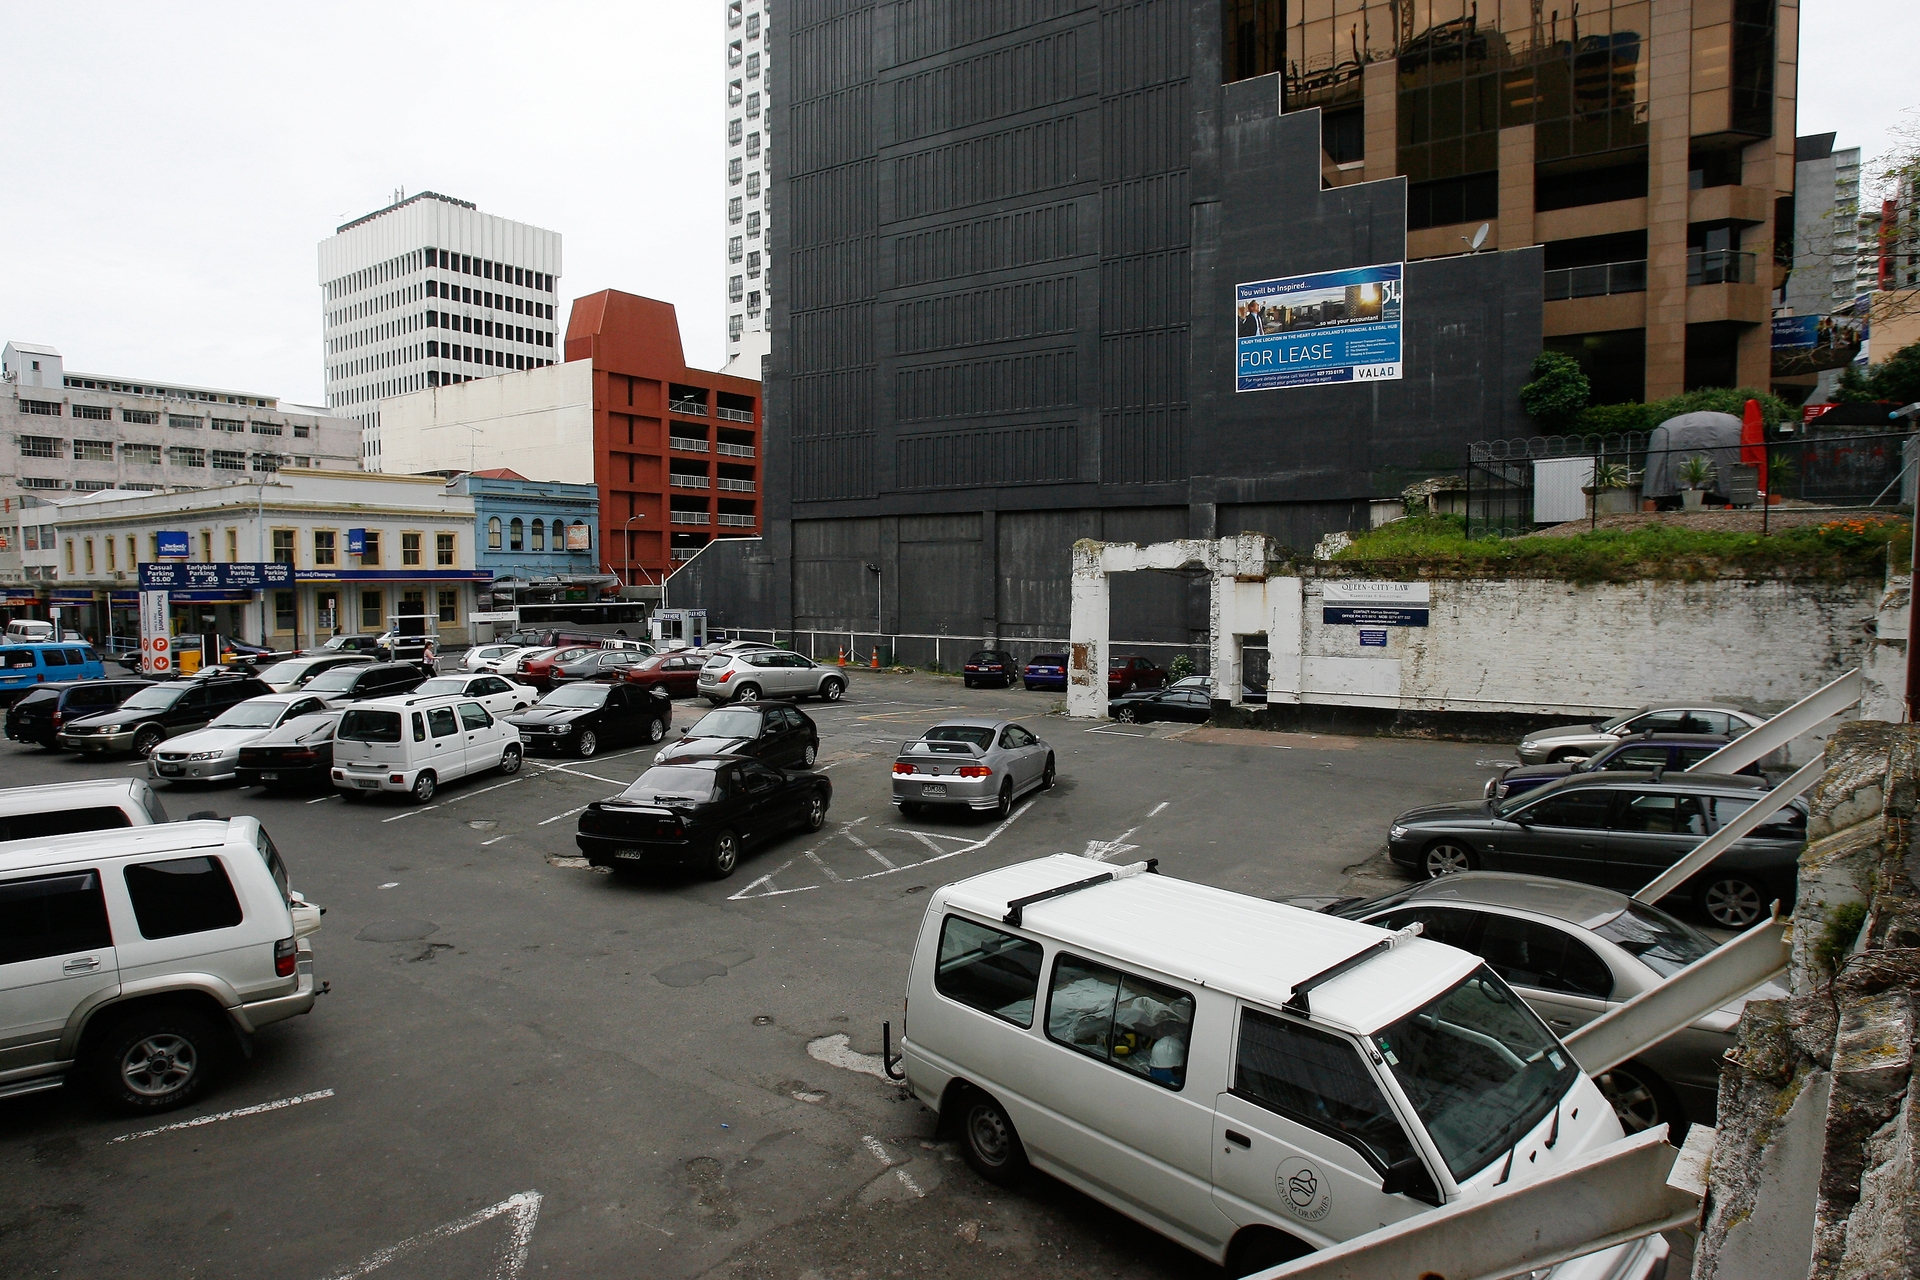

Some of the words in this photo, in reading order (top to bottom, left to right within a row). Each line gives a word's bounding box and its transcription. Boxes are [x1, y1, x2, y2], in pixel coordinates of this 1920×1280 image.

[1240, 350, 1273, 367] FOR
[1279, 343, 1333, 363] LEASE
[1358, 366, 1394, 378] VALAD
[1342, 583, 1366, 591] QUEEN
[1278, 1176, 1297, 1212] CUSTOM
[1298, 1195, 1330, 1219] DRAPERIES
